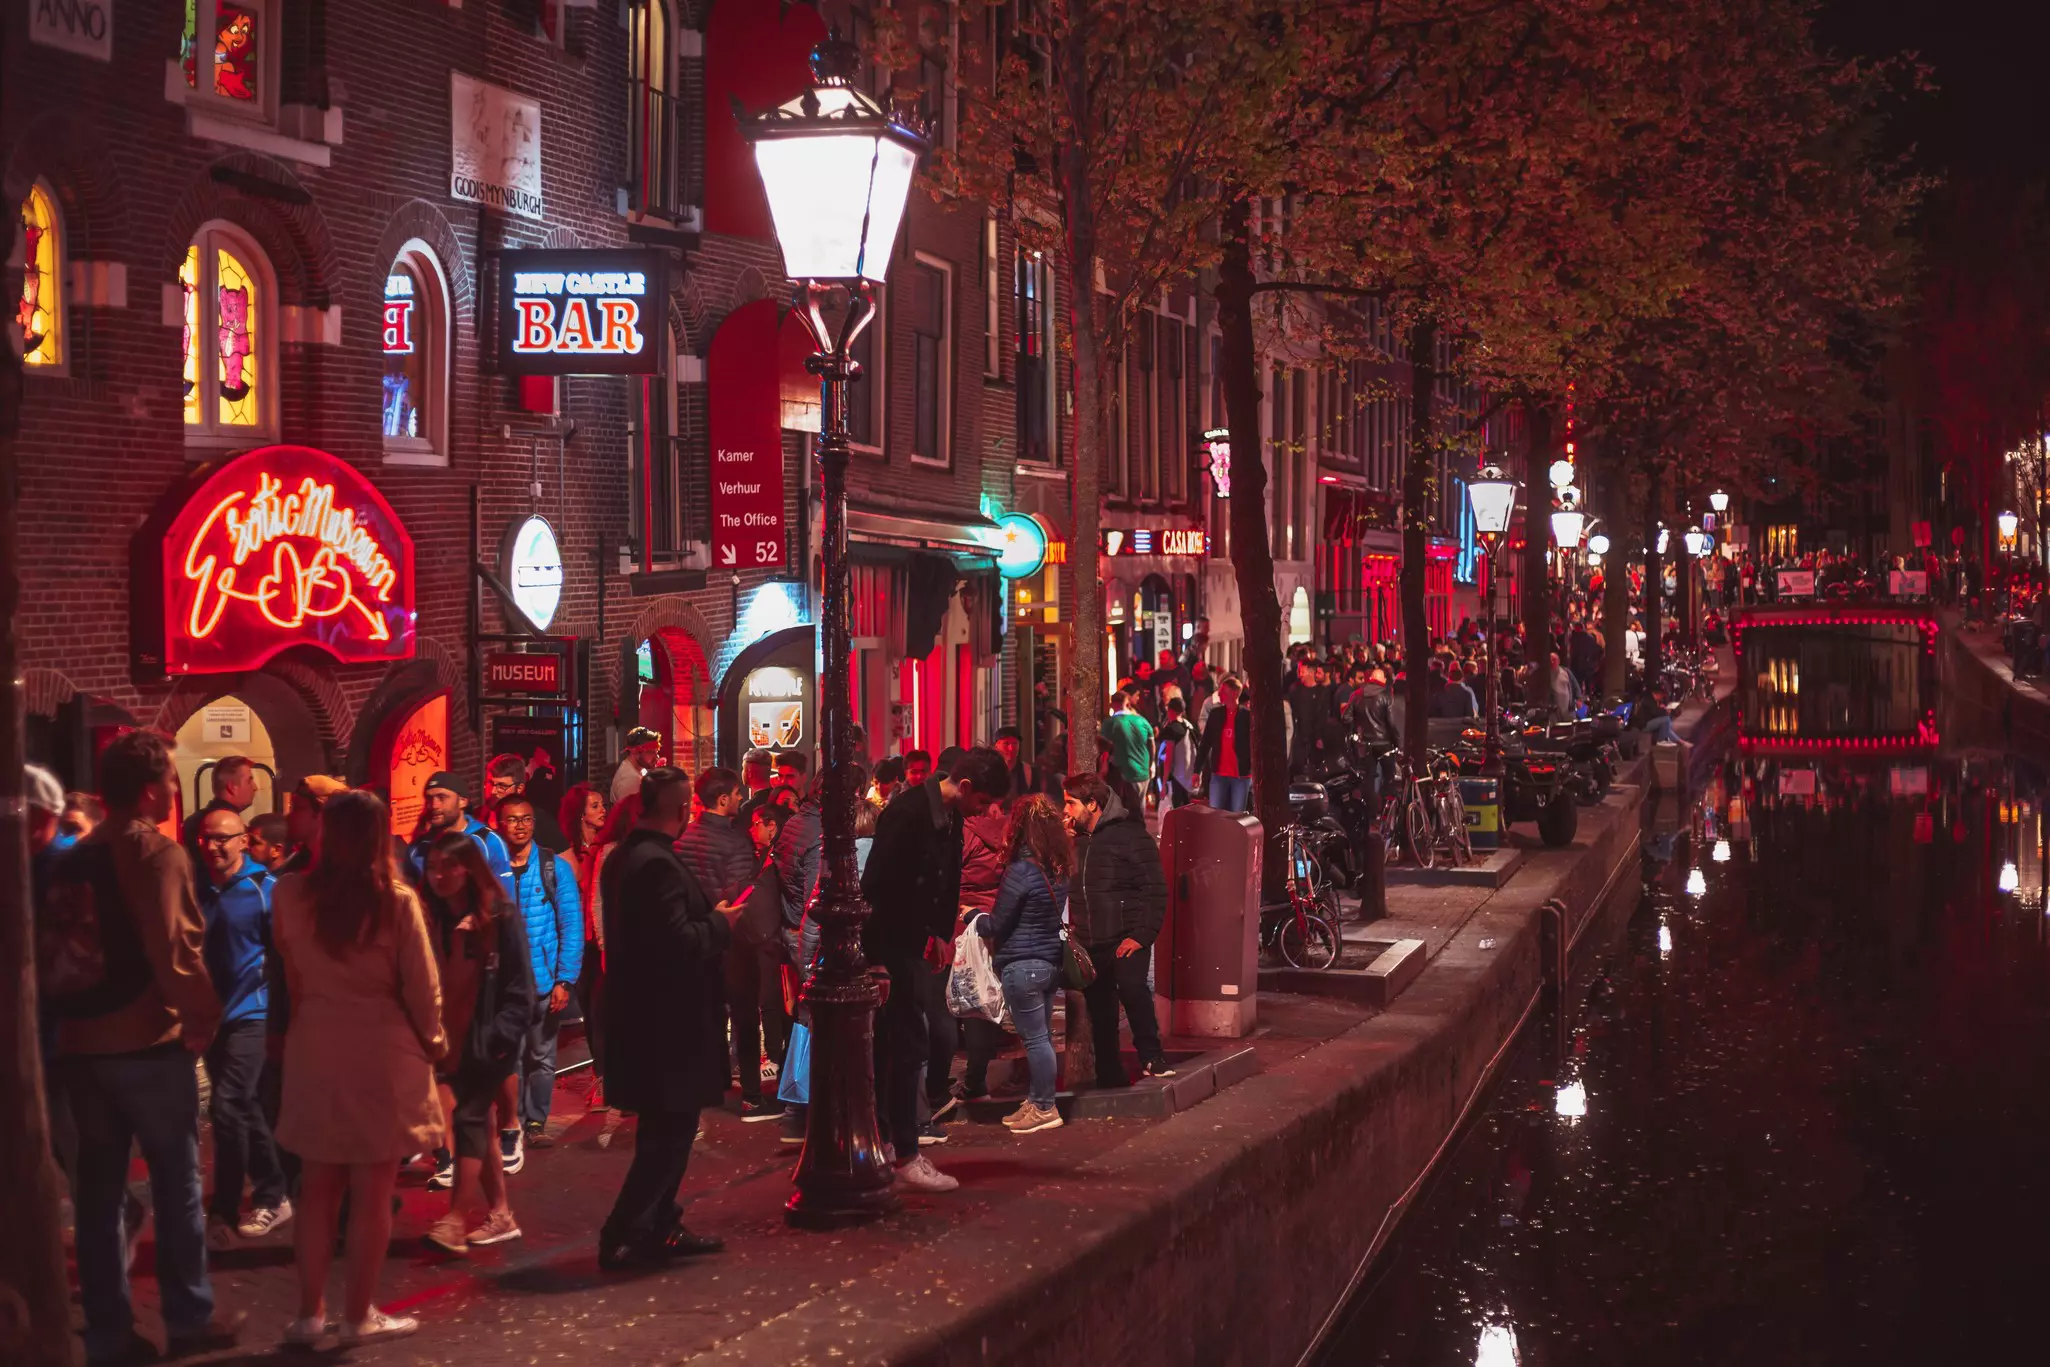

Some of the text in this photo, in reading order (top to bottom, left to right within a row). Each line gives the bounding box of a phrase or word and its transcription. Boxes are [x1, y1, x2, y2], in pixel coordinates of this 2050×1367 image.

[36, 0, 106, 41] ANNO
[513, 298, 643, 353] BAR
[718, 449, 754, 462] Kamer
[720, 481, 761, 495] Verhuur
[720, 512, 777, 527] The Office
[1163, 530, 1186, 554] CASA
[755, 541, 778, 562] 52
[492, 665, 555, 681] MUSEUM
